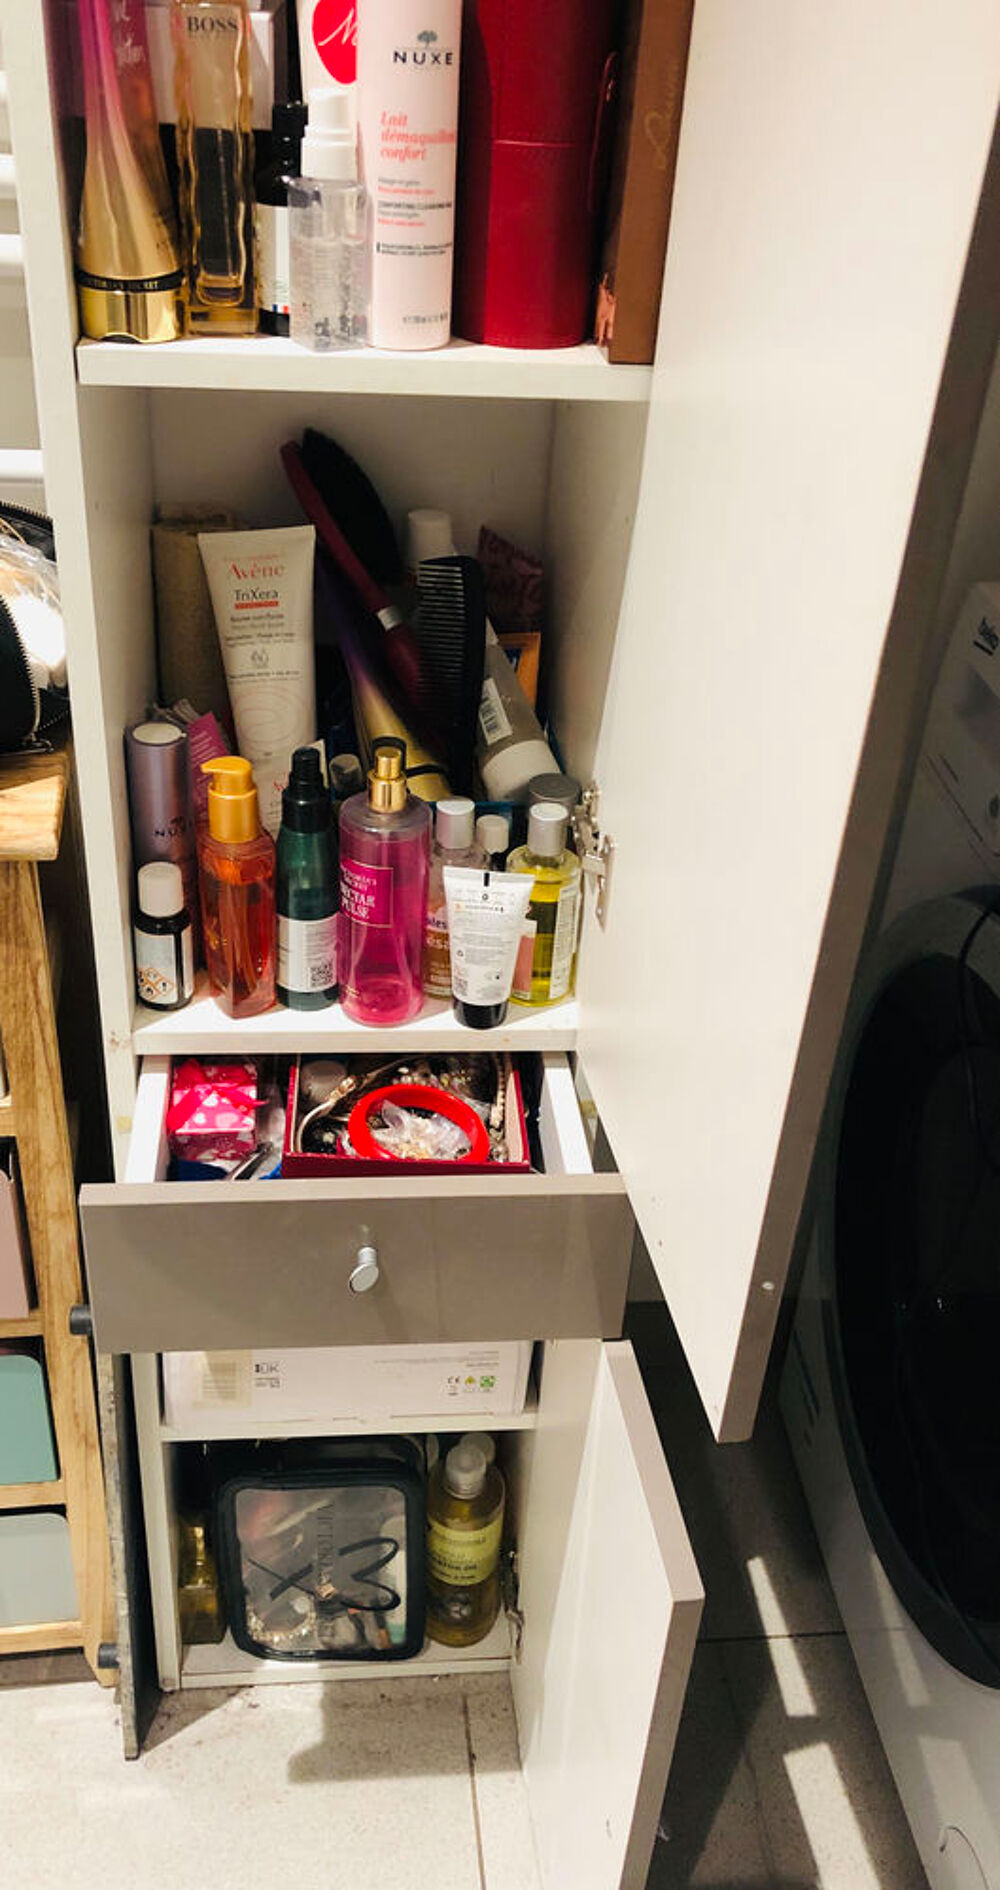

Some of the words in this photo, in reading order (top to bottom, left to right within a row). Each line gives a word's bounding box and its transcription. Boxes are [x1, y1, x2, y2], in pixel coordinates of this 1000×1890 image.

[187, 16, 239, 31] BOSS
[393, 51, 453, 65] NUXE
[381, 111, 409, 126] Lait
[380, 147, 427, 162] confort
[230, 561, 285, 580] Avène
[234, 587, 280, 601] TriXera
